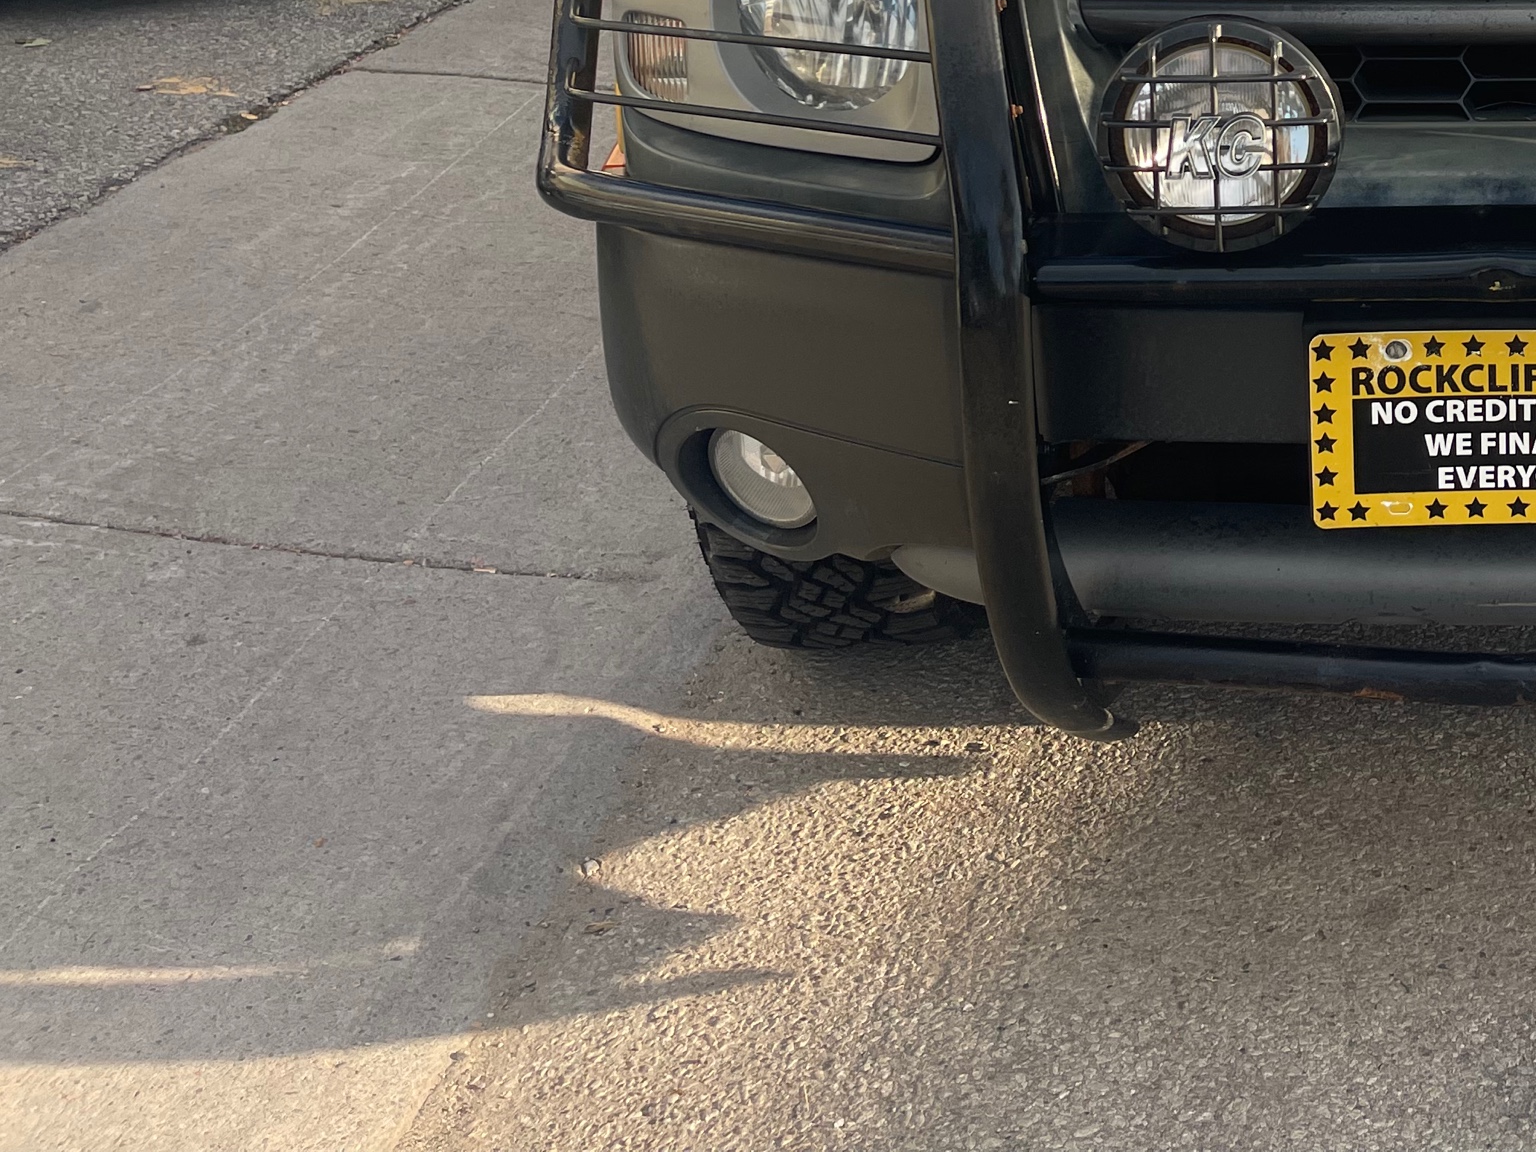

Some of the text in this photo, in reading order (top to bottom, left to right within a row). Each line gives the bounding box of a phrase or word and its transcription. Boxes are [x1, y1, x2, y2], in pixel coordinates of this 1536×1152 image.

[1165, 112, 1266, 180] KC
[1371, 401, 1418, 425] NO
[1425, 398, 1536, 423] CREDIT
[1424, 432, 1472, 457] WE
